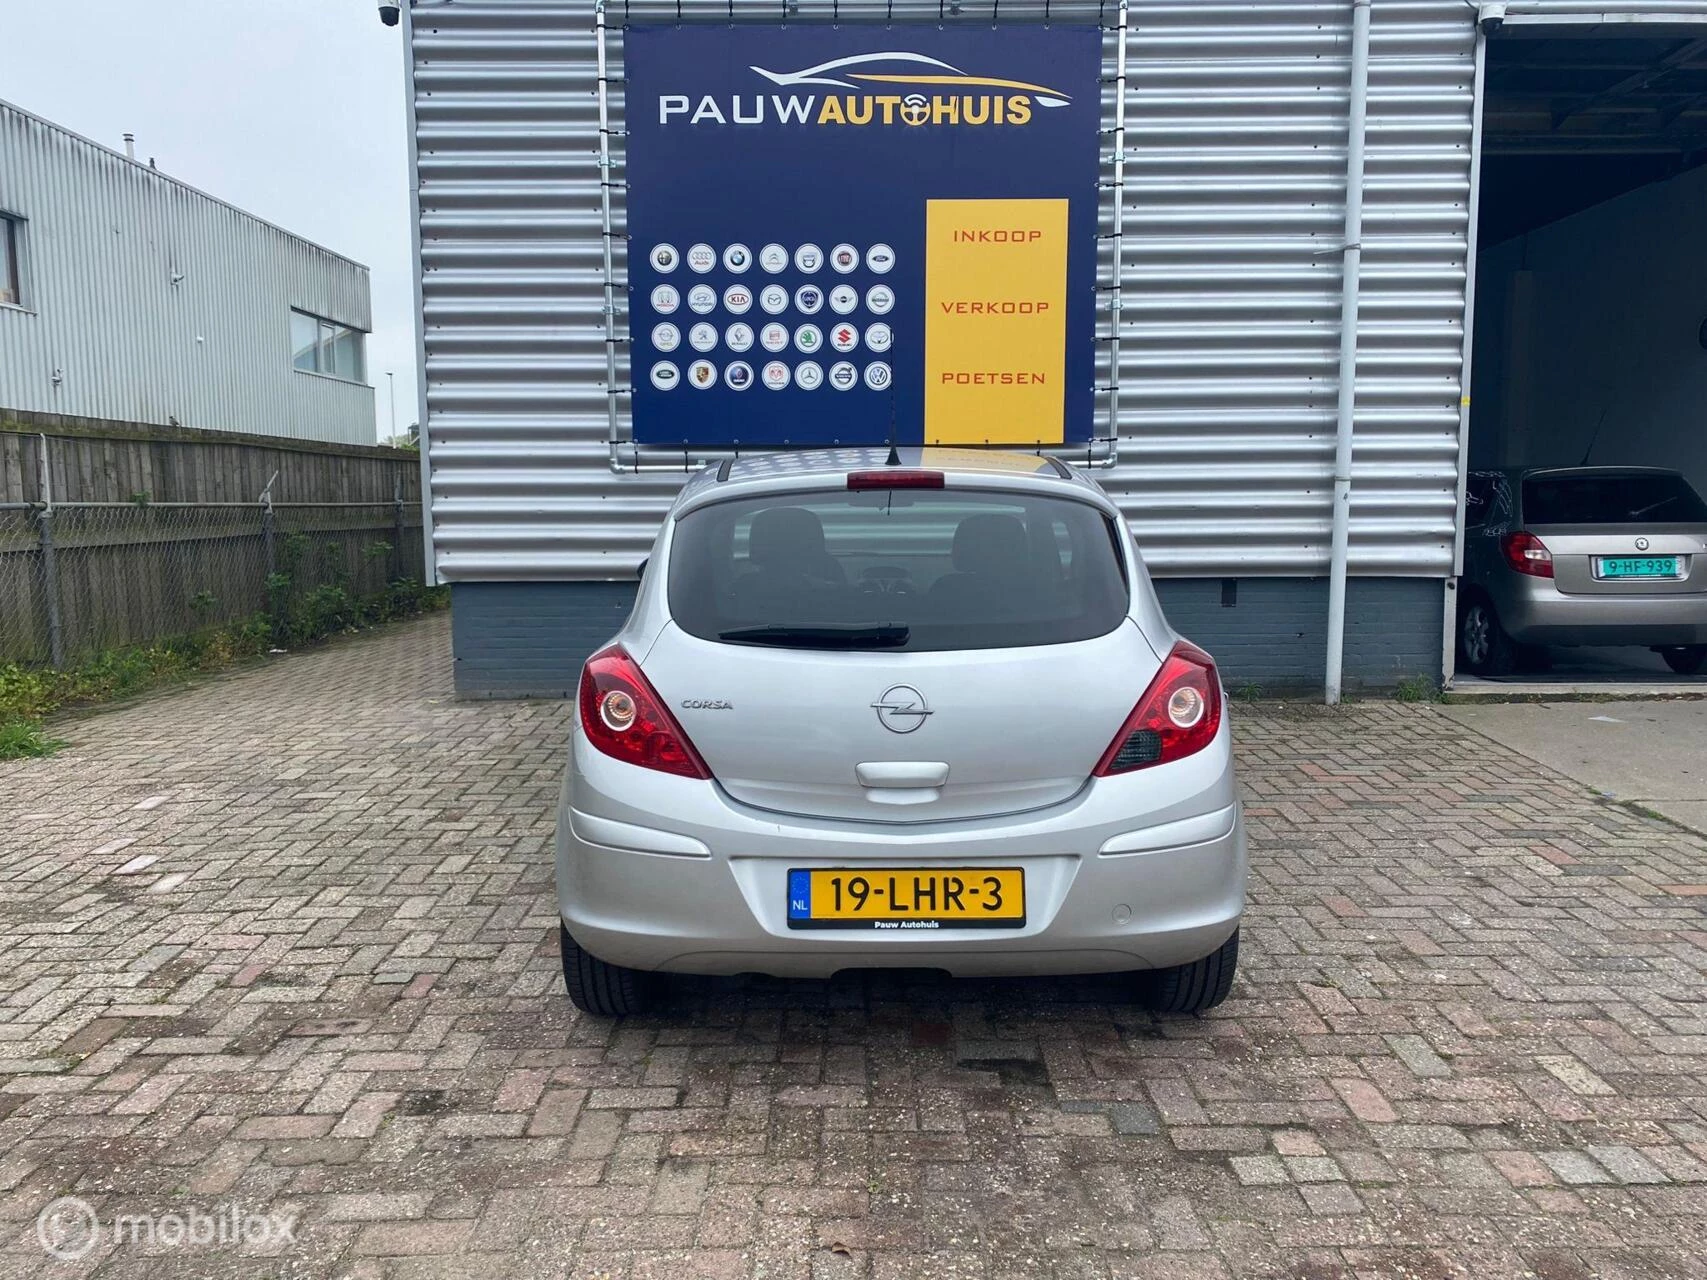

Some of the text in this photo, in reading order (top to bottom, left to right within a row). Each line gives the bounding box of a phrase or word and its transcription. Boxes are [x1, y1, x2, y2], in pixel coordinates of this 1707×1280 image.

[953, 230, 1042, 243] INKOOP
[941, 302, 1049, 314] VERKOOP
[942, 372, 1046, 385] POETSEN
[1609, 559, 1673, 573] 9-HF-939
[680, 699, 734, 710] CORSA
[831, 876, 1003, 912] 19-LHR-3
[792, 900, 808, 911] NL
[874, 920, 940, 929] Pauw Autohuis
